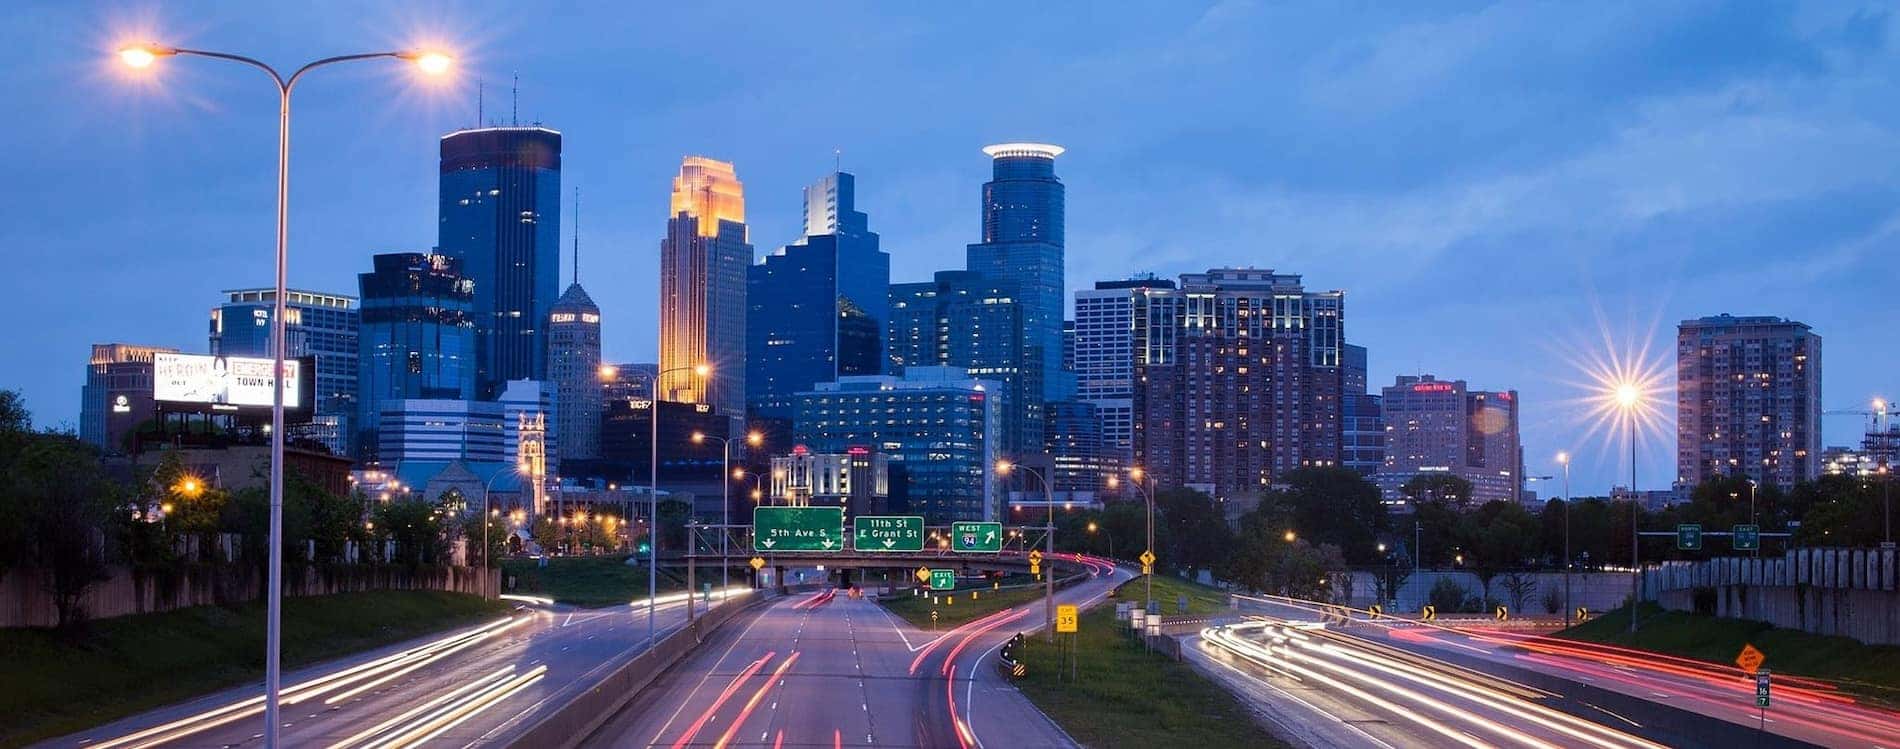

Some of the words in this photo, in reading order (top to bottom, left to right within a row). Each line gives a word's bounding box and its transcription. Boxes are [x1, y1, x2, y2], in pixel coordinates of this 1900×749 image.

[237, 377, 264, 388] TOWN
[268, 379, 292, 389] HL
[871, 519, 891, 528] 11th
[896, 519, 907, 528] St
[770, 528, 790, 537] 5th
[795, 528, 814, 537] Ave
[819, 528, 826, 537] S
[860, 529, 867, 538] E
[872, 529, 901, 538] Grant
[906, 529, 918, 538] St
[964, 537, 975, 545] 94
[1061, 616, 1073, 625] 35
